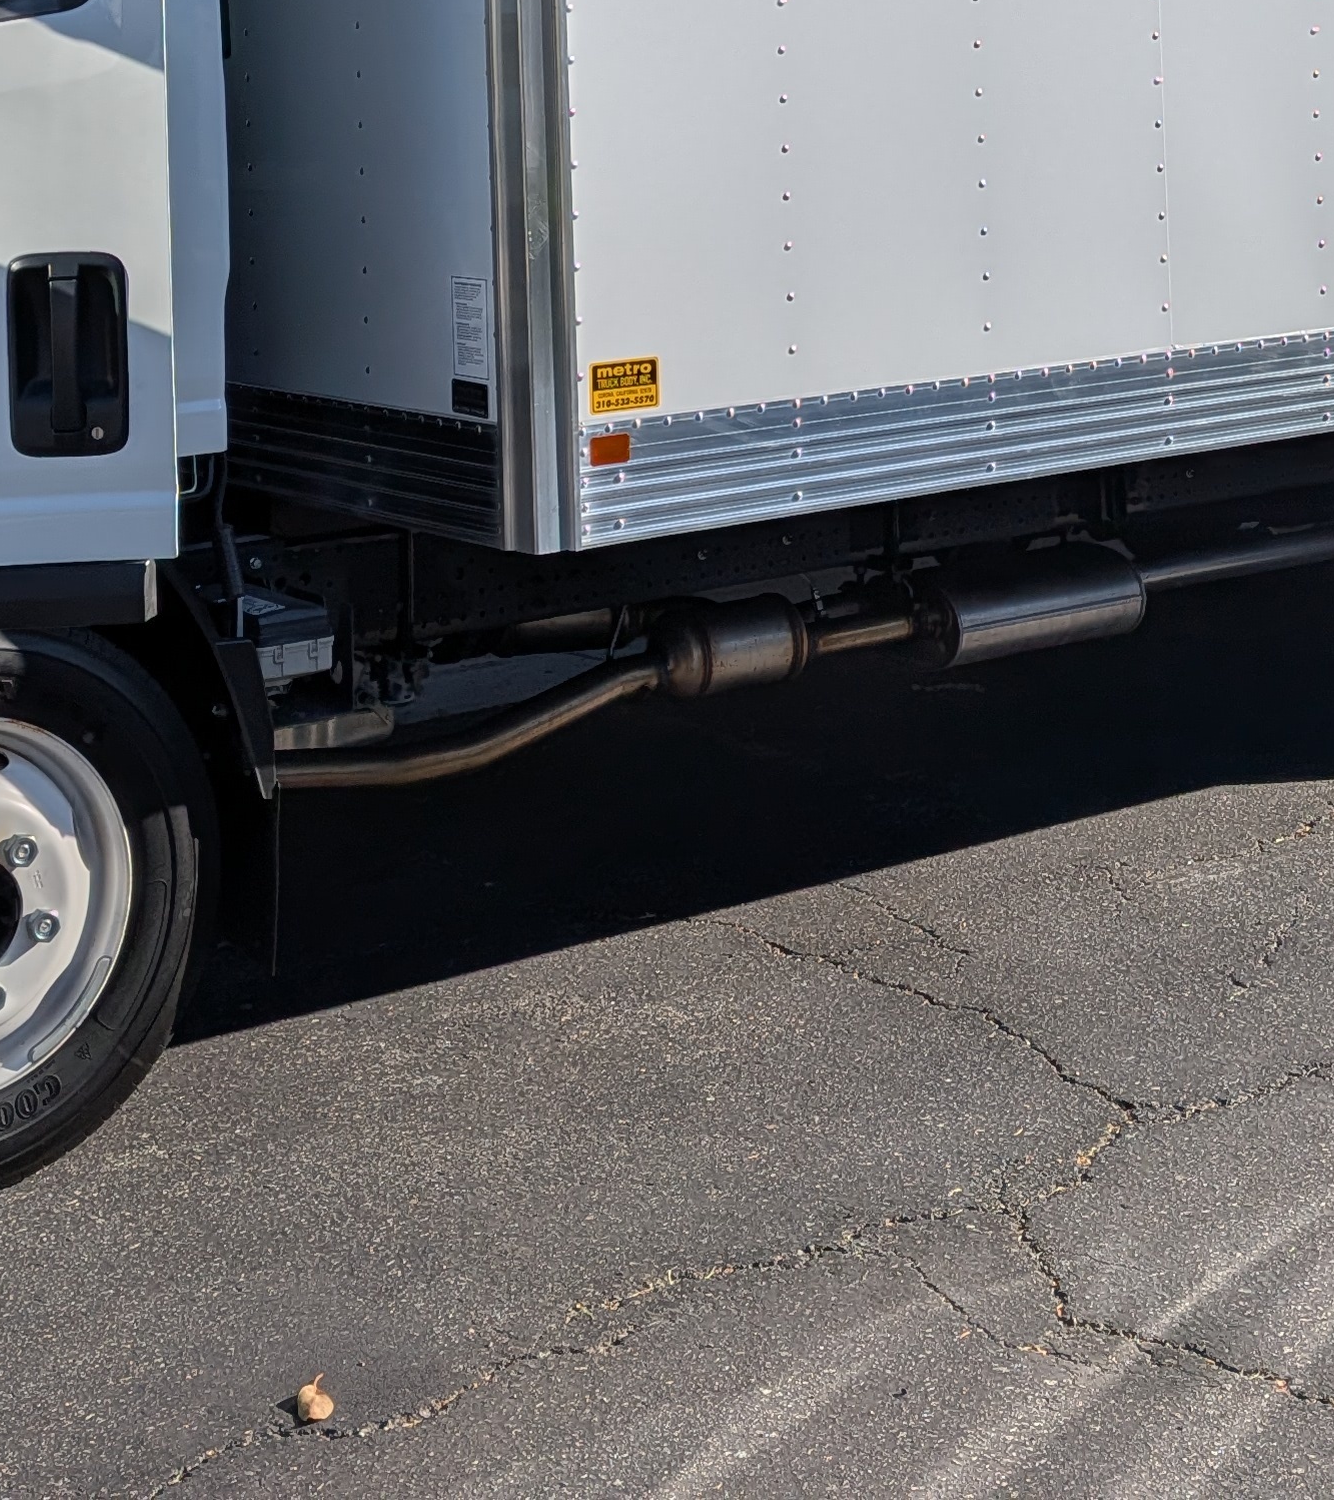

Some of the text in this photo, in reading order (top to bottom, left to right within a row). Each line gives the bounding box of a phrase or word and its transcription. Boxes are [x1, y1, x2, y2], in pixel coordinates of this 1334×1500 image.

[597, 363, 652, 378] metro
[597, 377, 619, 389] TRUCK
[596, 395, 654, 409] 310-532-5570
